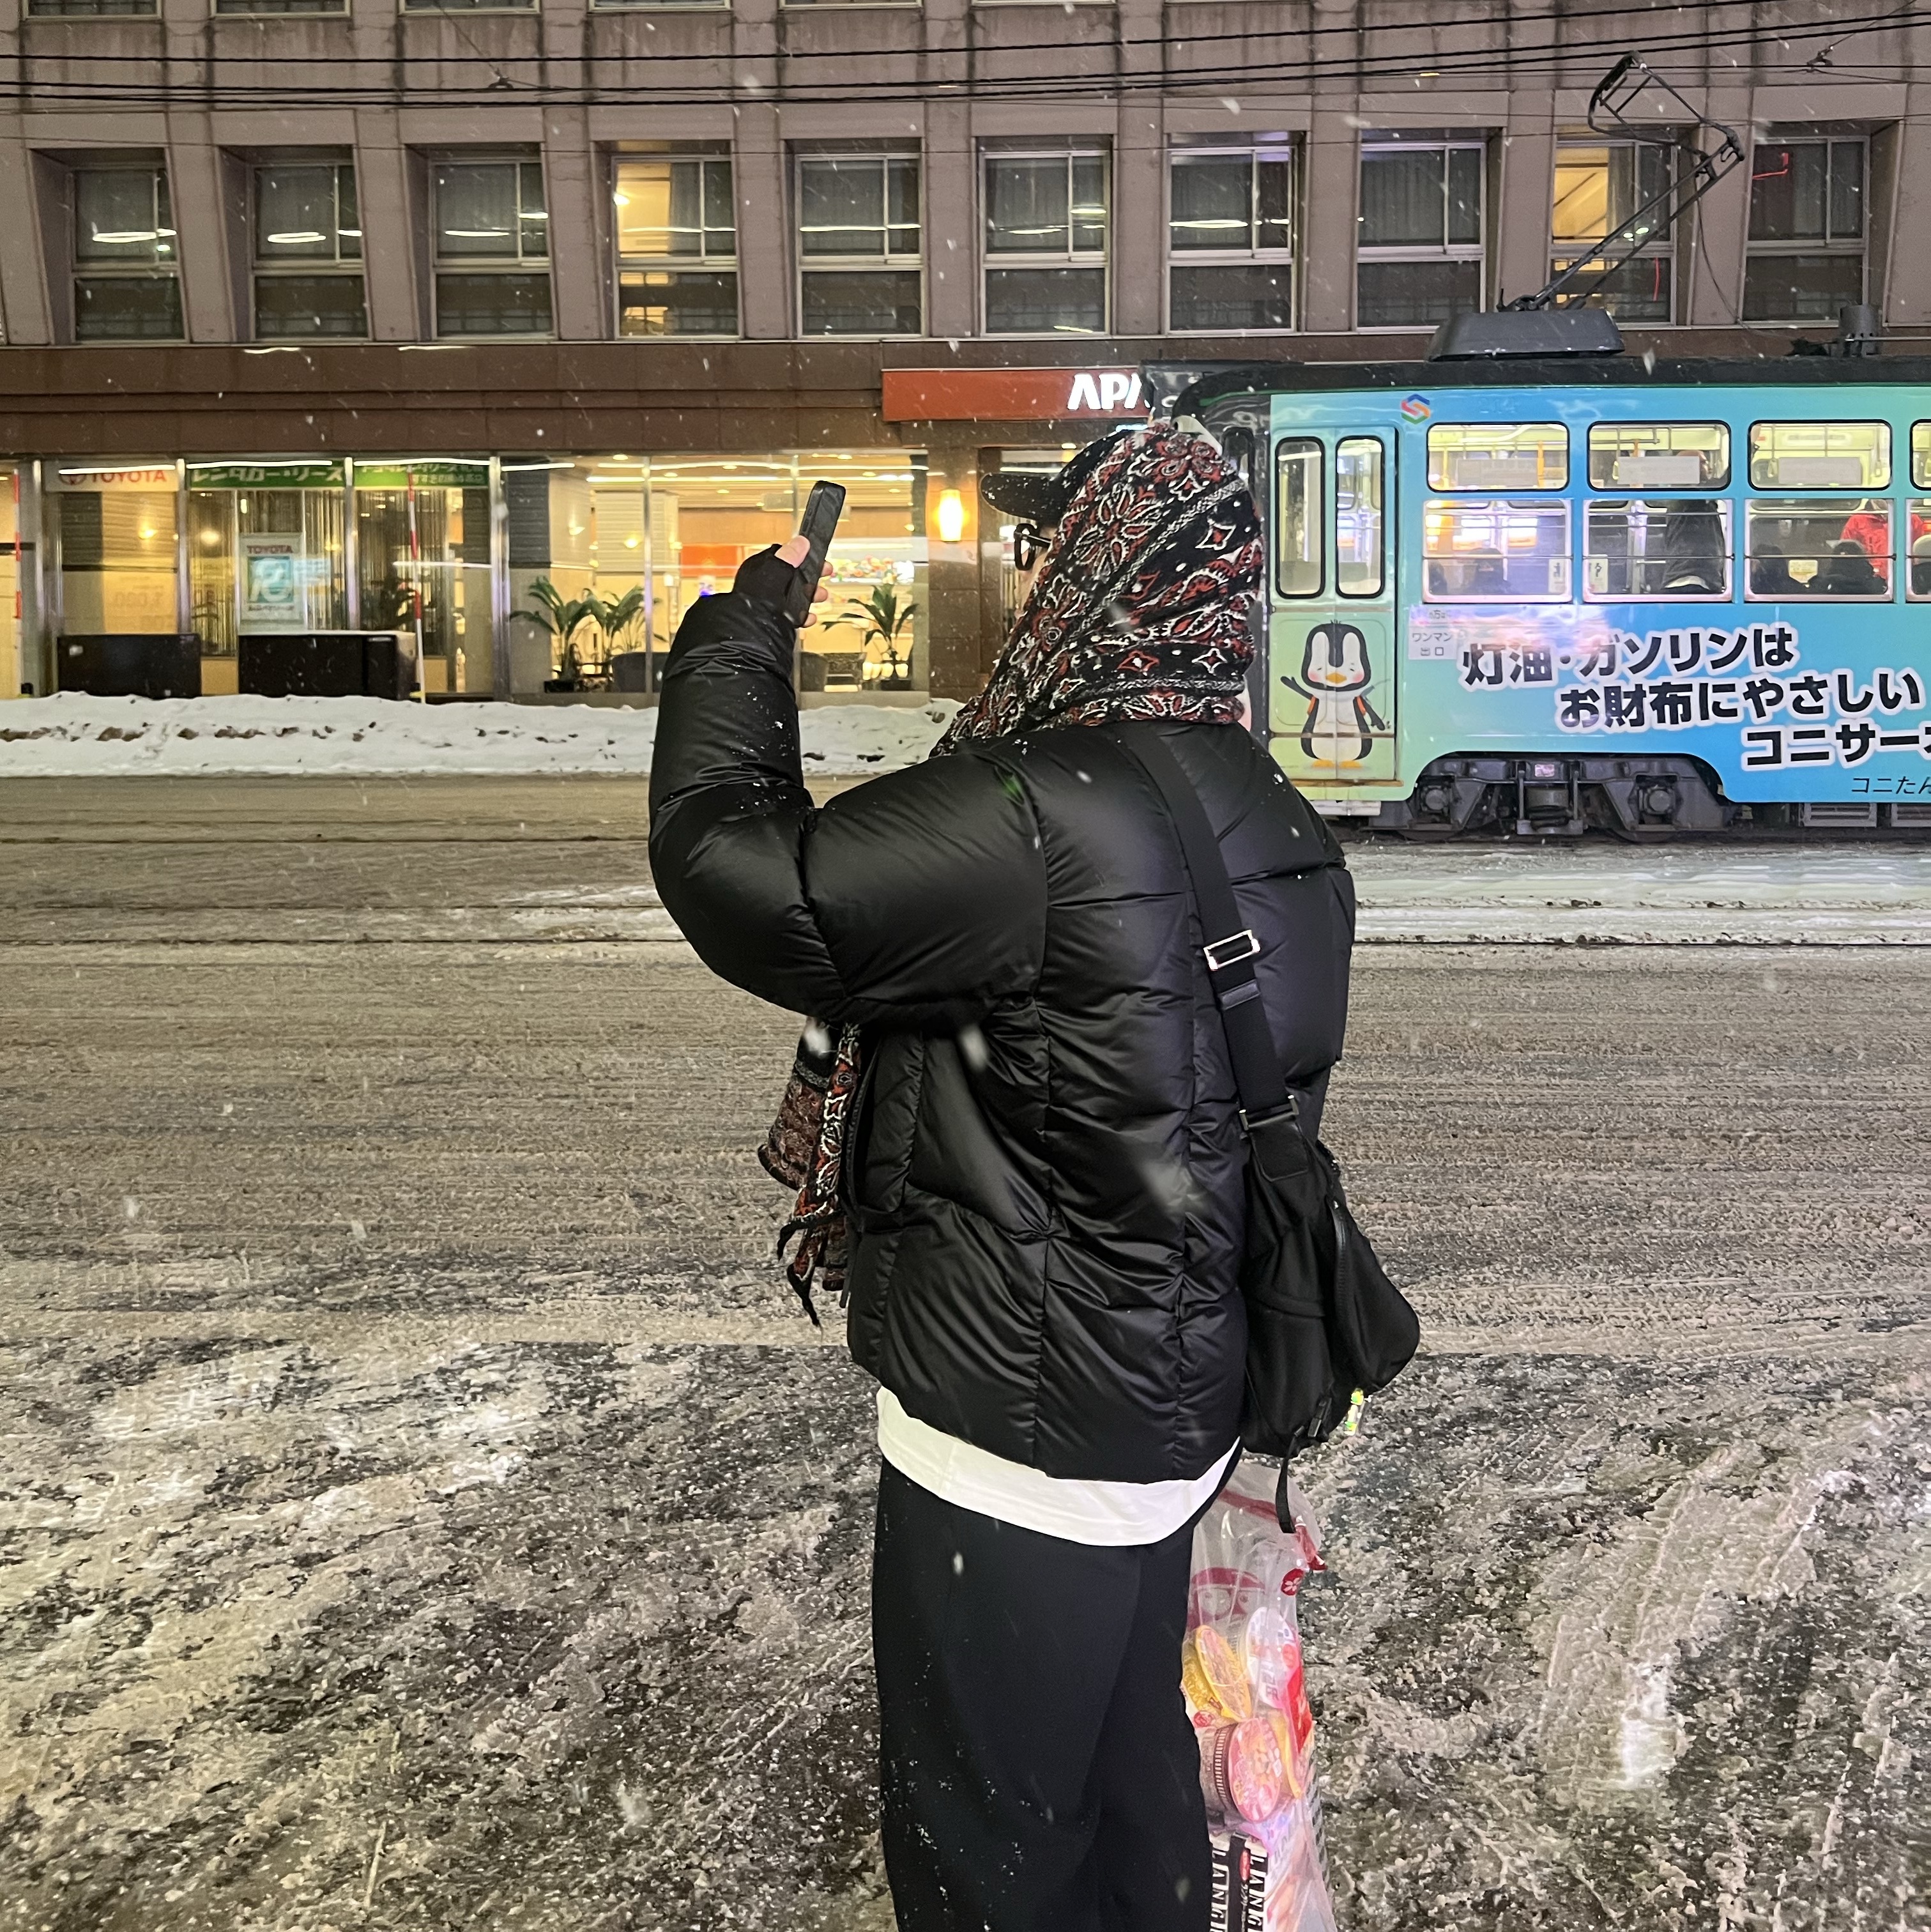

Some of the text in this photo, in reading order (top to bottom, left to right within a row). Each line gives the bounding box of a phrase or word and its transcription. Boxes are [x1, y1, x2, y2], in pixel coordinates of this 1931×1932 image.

[91, 470, 167, 483] TOYOTA
[247, 545, 294, 554] TOYOTA
[1412, 632, 1453, 642] ワンマン
[1420, 646, 1444, 656] 出口
[1462, 627, 1794, 686] 灯油・ガソリンは
[1561, 673, 1921, 728] お財布にやさしい
[1747, 723, 1931, 765] コニサー
